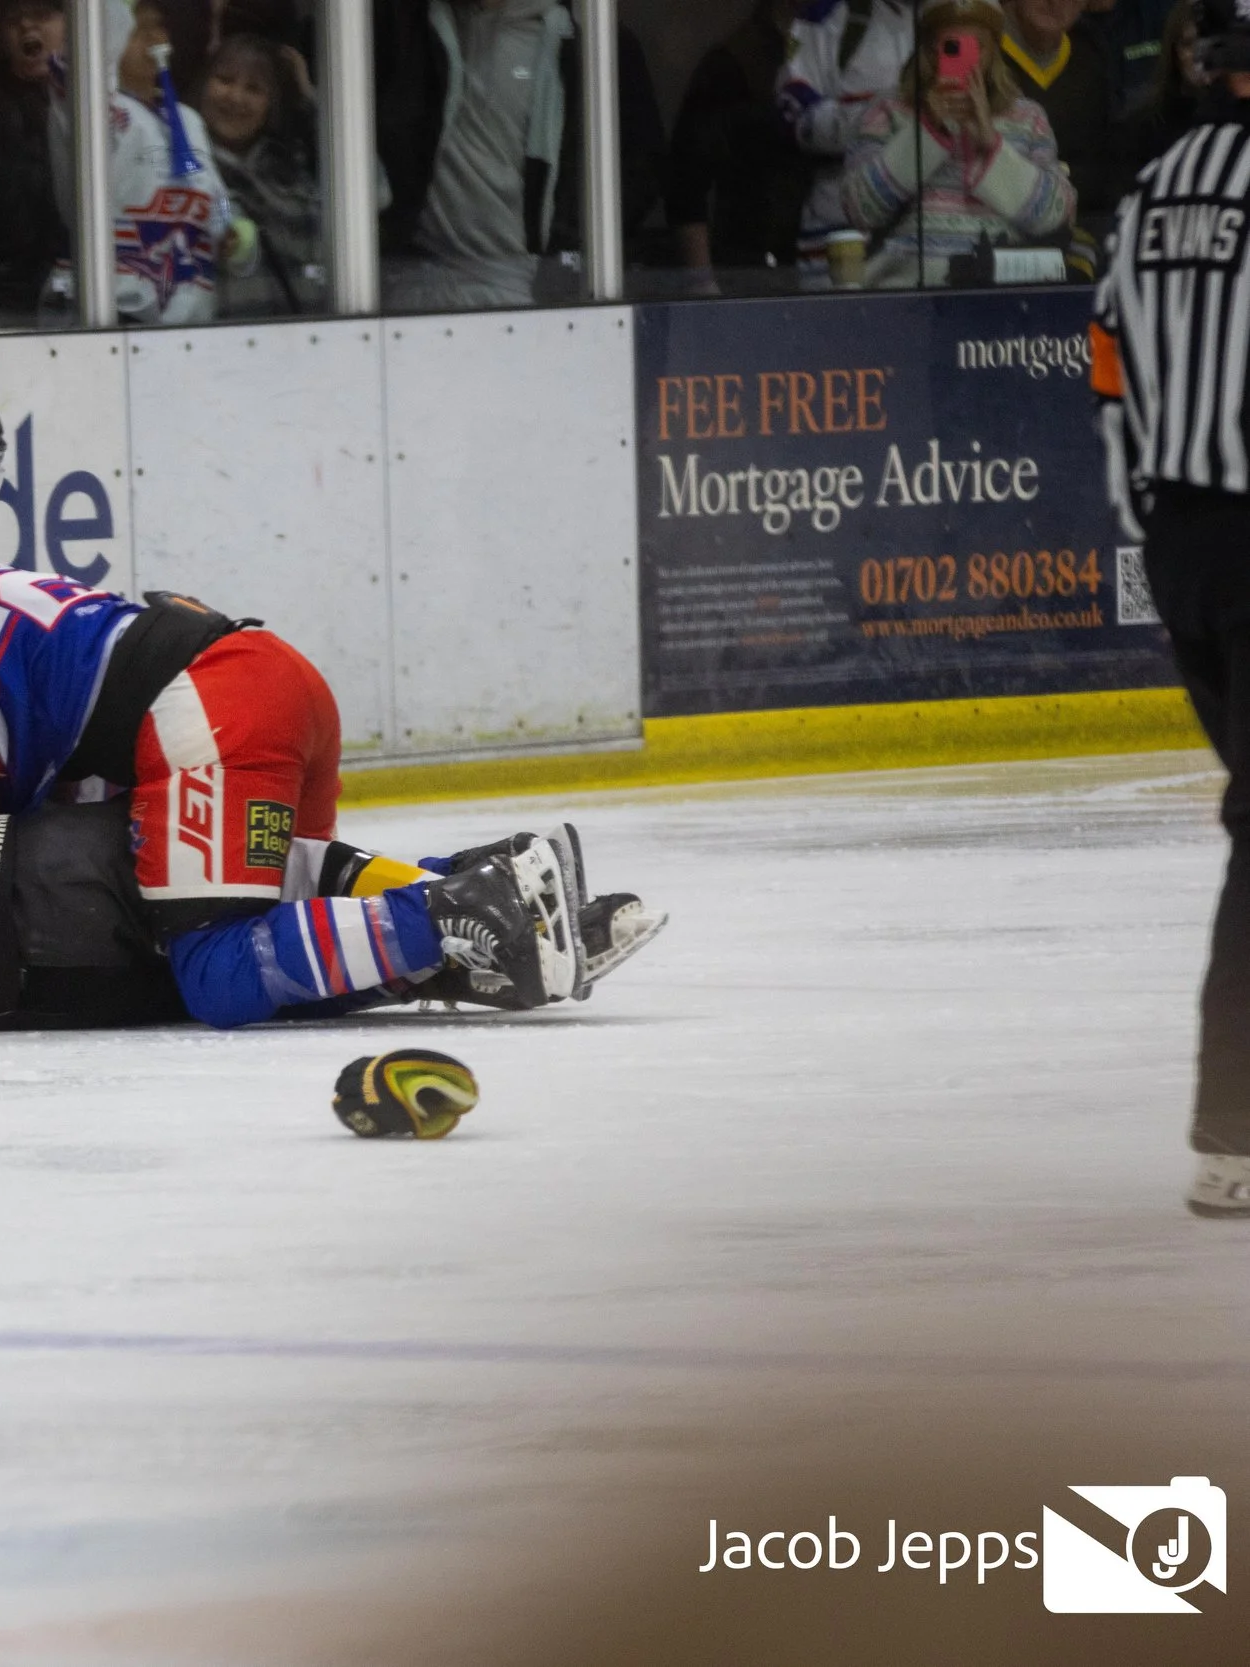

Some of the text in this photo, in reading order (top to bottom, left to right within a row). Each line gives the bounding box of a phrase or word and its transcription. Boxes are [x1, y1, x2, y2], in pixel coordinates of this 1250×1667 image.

[123, 187, 212, 222] JETS
[1138, 203, 1244, 261] EVANS
[657, 368, 888, 441] FEE FREE
[658, 440, 1039, 535] Mortgage Advice
[860, 554, 958, 605] 01702
[968, 549, 1103, 598] 880384
[861, 602, 1104, 641] www.mortgageandco.co.uk
[178, 763, 214, 884] JET
[250, 805, 281, 833] Fig
